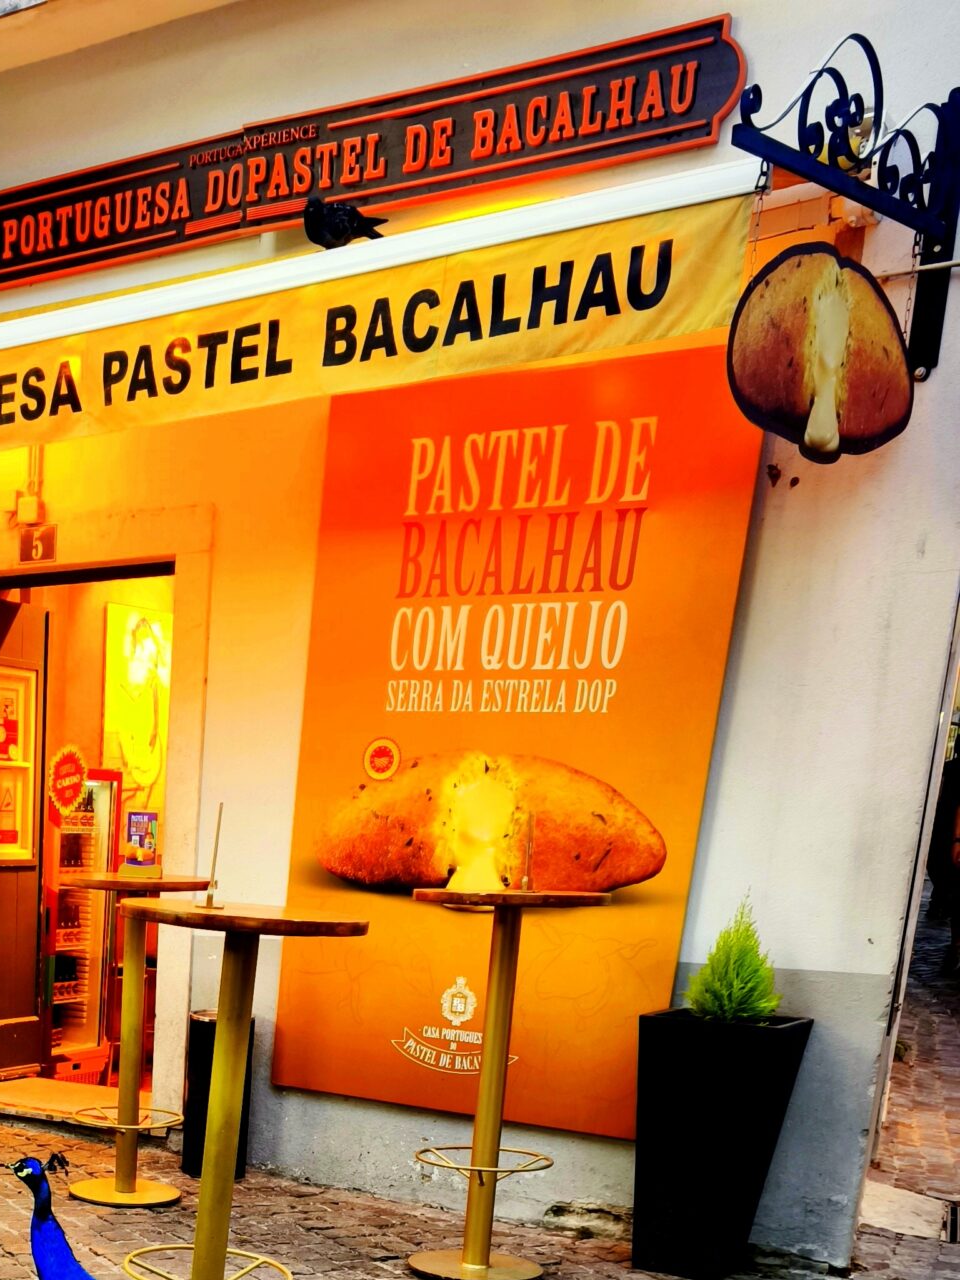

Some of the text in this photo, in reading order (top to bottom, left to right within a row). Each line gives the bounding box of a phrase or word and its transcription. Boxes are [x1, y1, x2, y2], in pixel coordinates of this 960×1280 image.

[3, 177, 190, 260] PORTUGUESA
[403, 117, 452, 174] DE
[471, 61, 699, 160] BACALHAU
[103, 319, 293, 406] PASTEL
[323, 239, 673, 367] BACALHAU
[404, 416, 658, 516] PASTEL DE
[31, 527, 46, 560] 5
[395, 507, 648, 599] BACALHAU
[390, 600, 628, 671] COM QUEIJO
[386, 679, 617, 713] SERRA DA ESTRELA DOP
[403, 1038, 436, 1065] PASTEL
[439, 1054, 453, 1069] DE
[422, 1026, 483, 1044] CASA PORTUGUES
